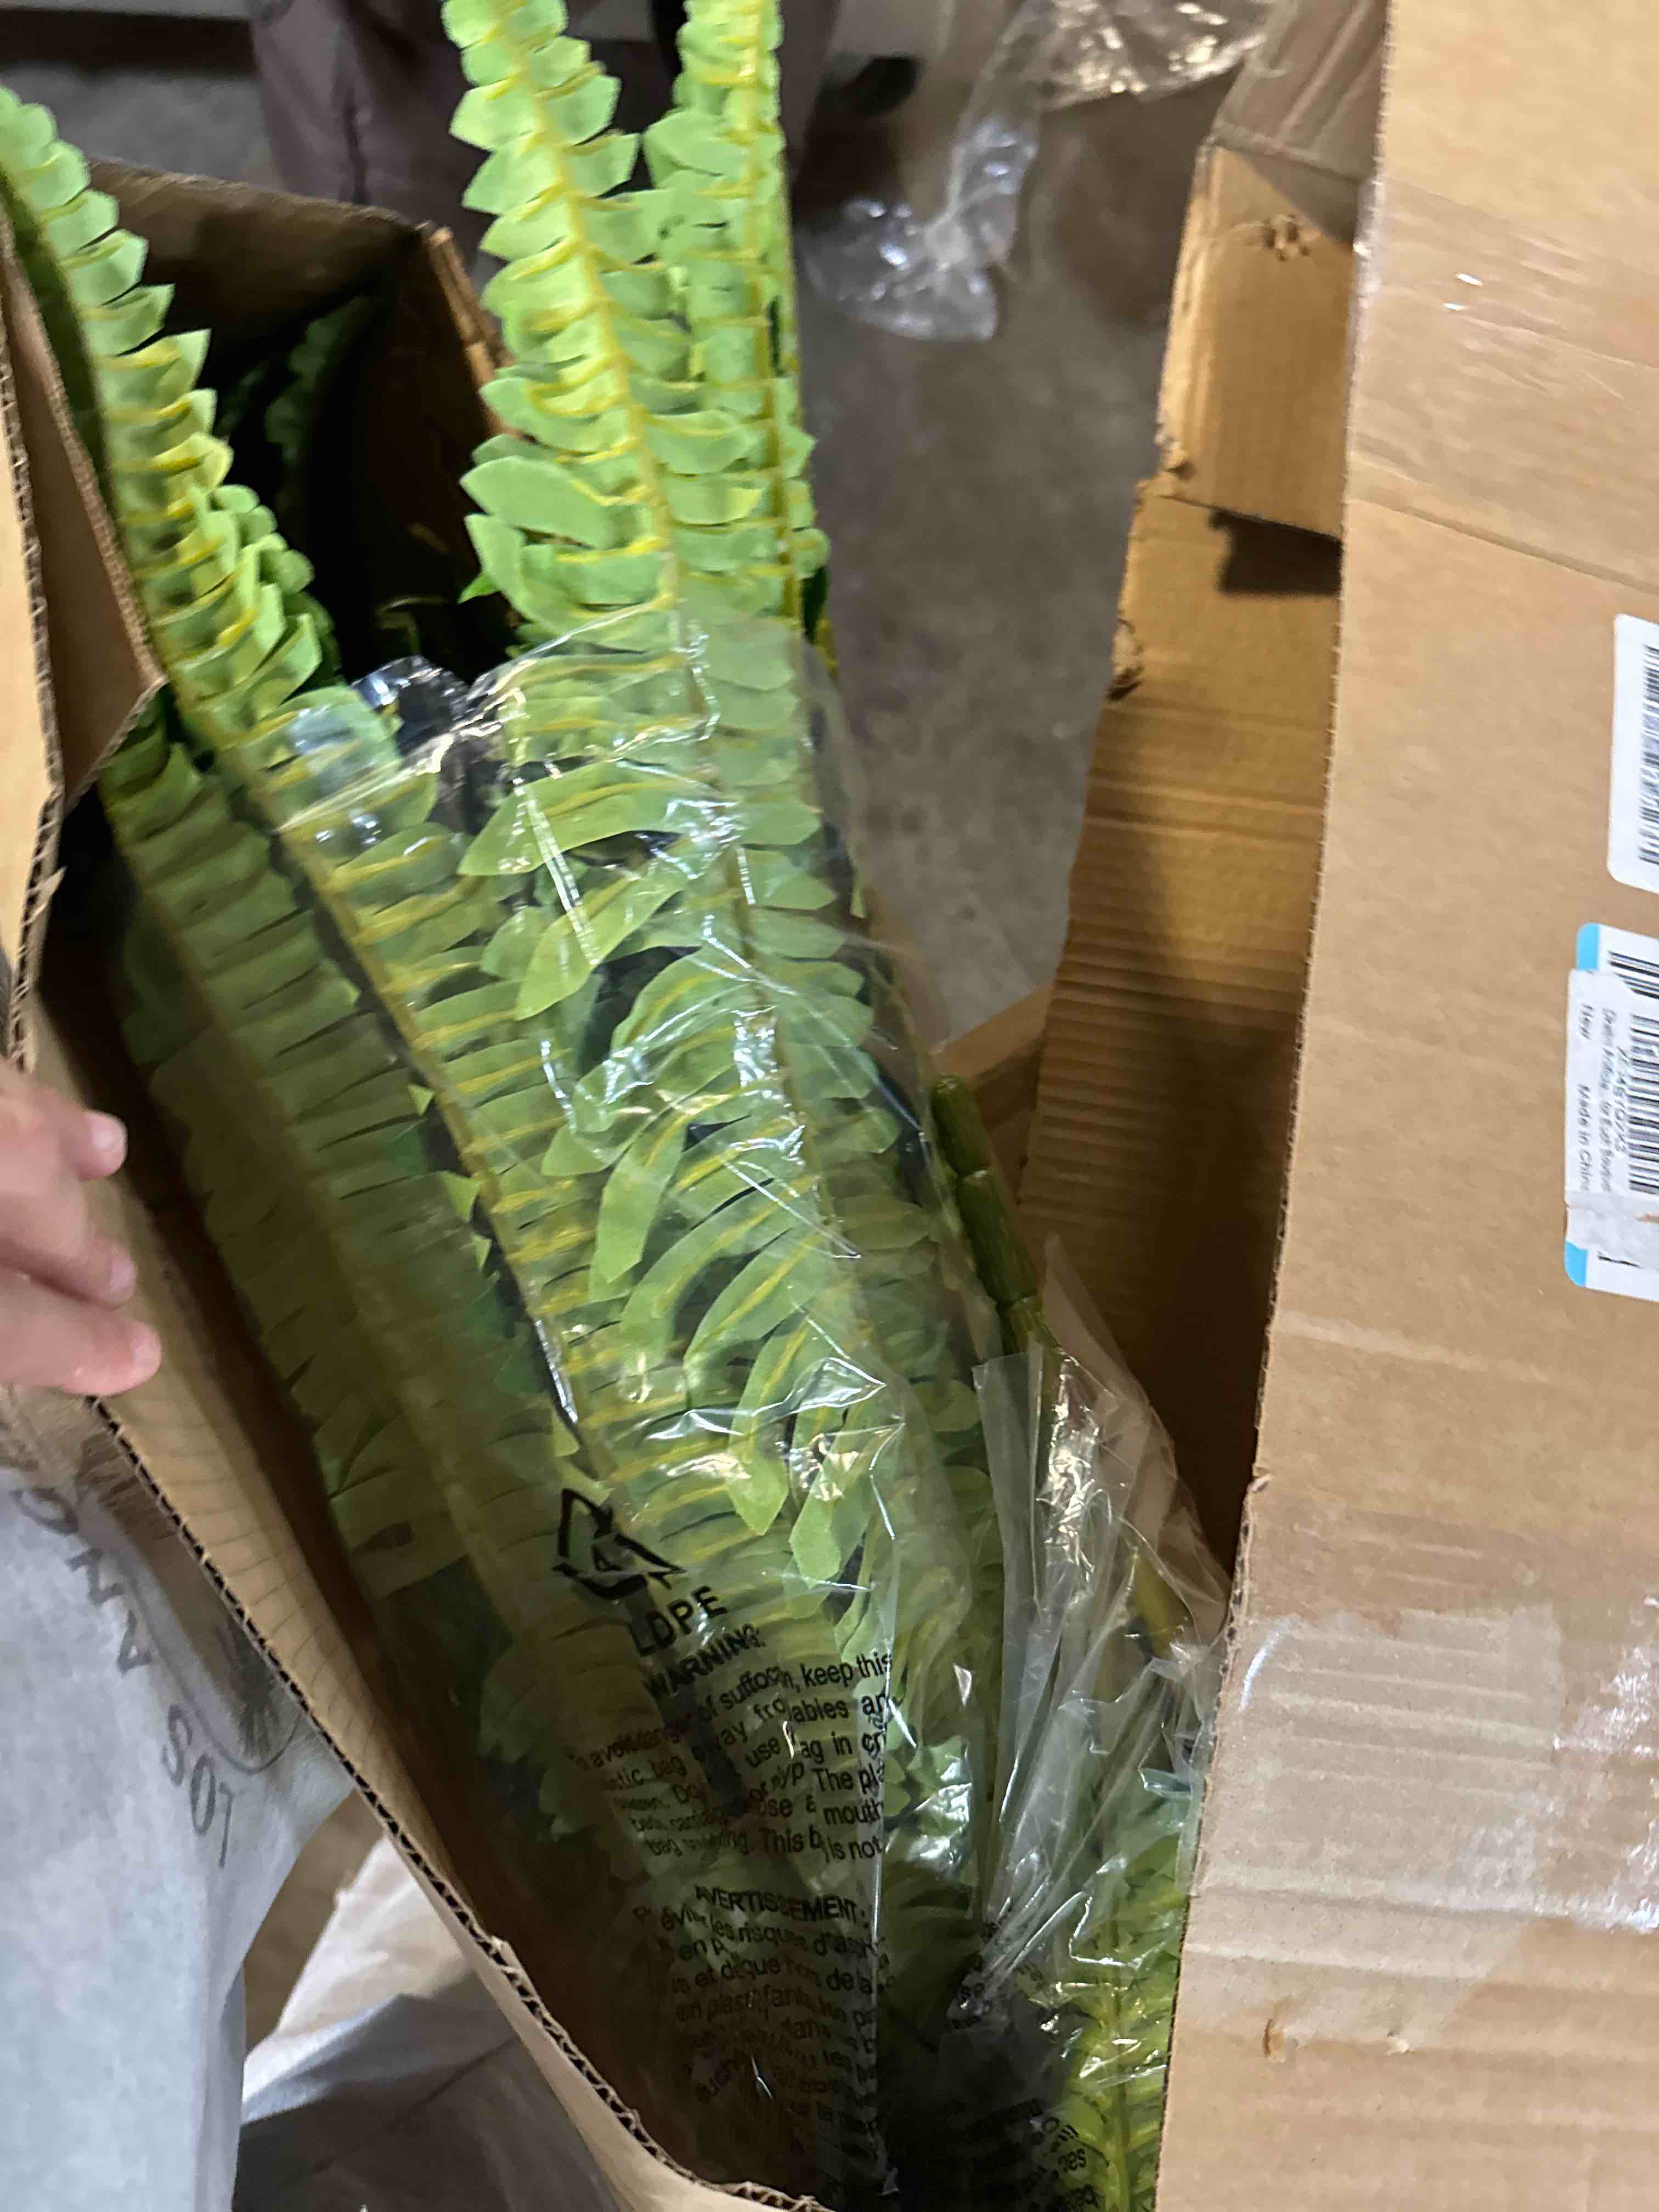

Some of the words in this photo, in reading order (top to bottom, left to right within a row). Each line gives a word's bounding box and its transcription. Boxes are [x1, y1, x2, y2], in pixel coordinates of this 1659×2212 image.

[1579, 1003, 1594, 1040] New
[1578, 1083, 1591, 1126] Made
[1578, 1130, 1590, 1146] in
[628, 1585, 729, 1658] LDPE
[800, 1662, 854, 1688] keep
[856, 1651, 893, 1678] this
[753, 1697, 787, 1723] fro
[746, 1736, 781, 1769] use
[799, 1739, 825, 1765] ag
[831, 1730, 854, 1756] in
[811, 1767, 854, 1792] The
[823, 1798, 884, 1826] mouth
[759, 1827, 804, 1854] This
[848, 1835, 882, 1860] not
[826, 1967, 854, 1991] de
